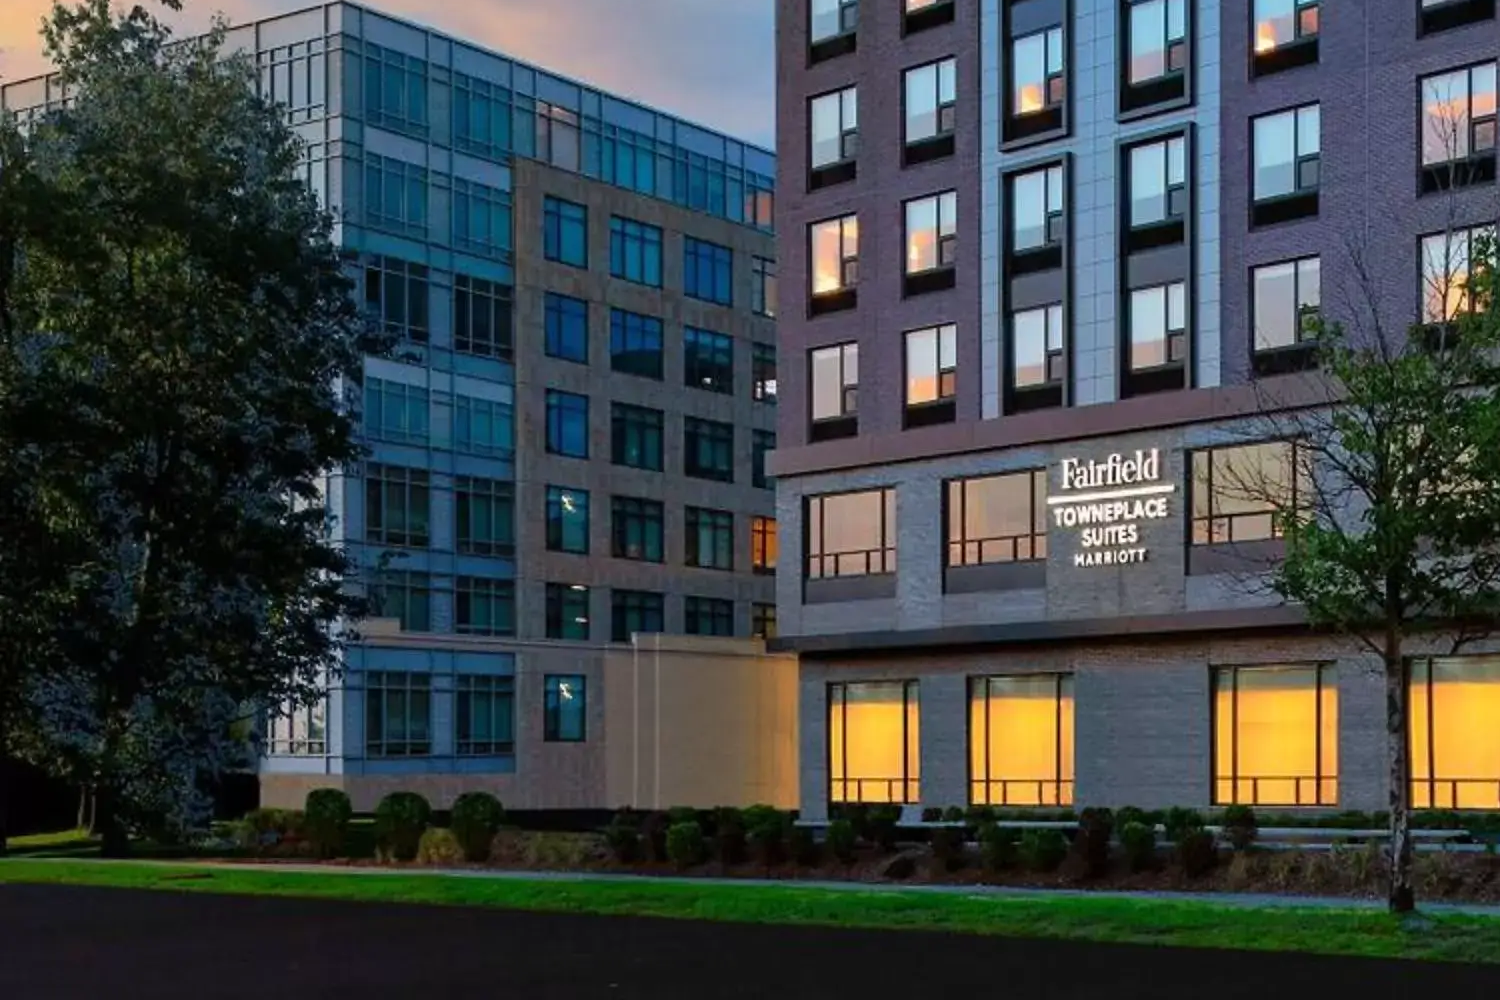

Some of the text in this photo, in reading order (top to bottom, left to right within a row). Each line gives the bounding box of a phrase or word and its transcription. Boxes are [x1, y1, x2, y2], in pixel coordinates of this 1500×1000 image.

[1061, 448, 1160, 489] Fairfield
[1053, 497, 1168, 527] TOWNEPLACE
[1081, 523, 1138, 547] SUITES
[1074, 548, 1147, 567] MARRIOTT
